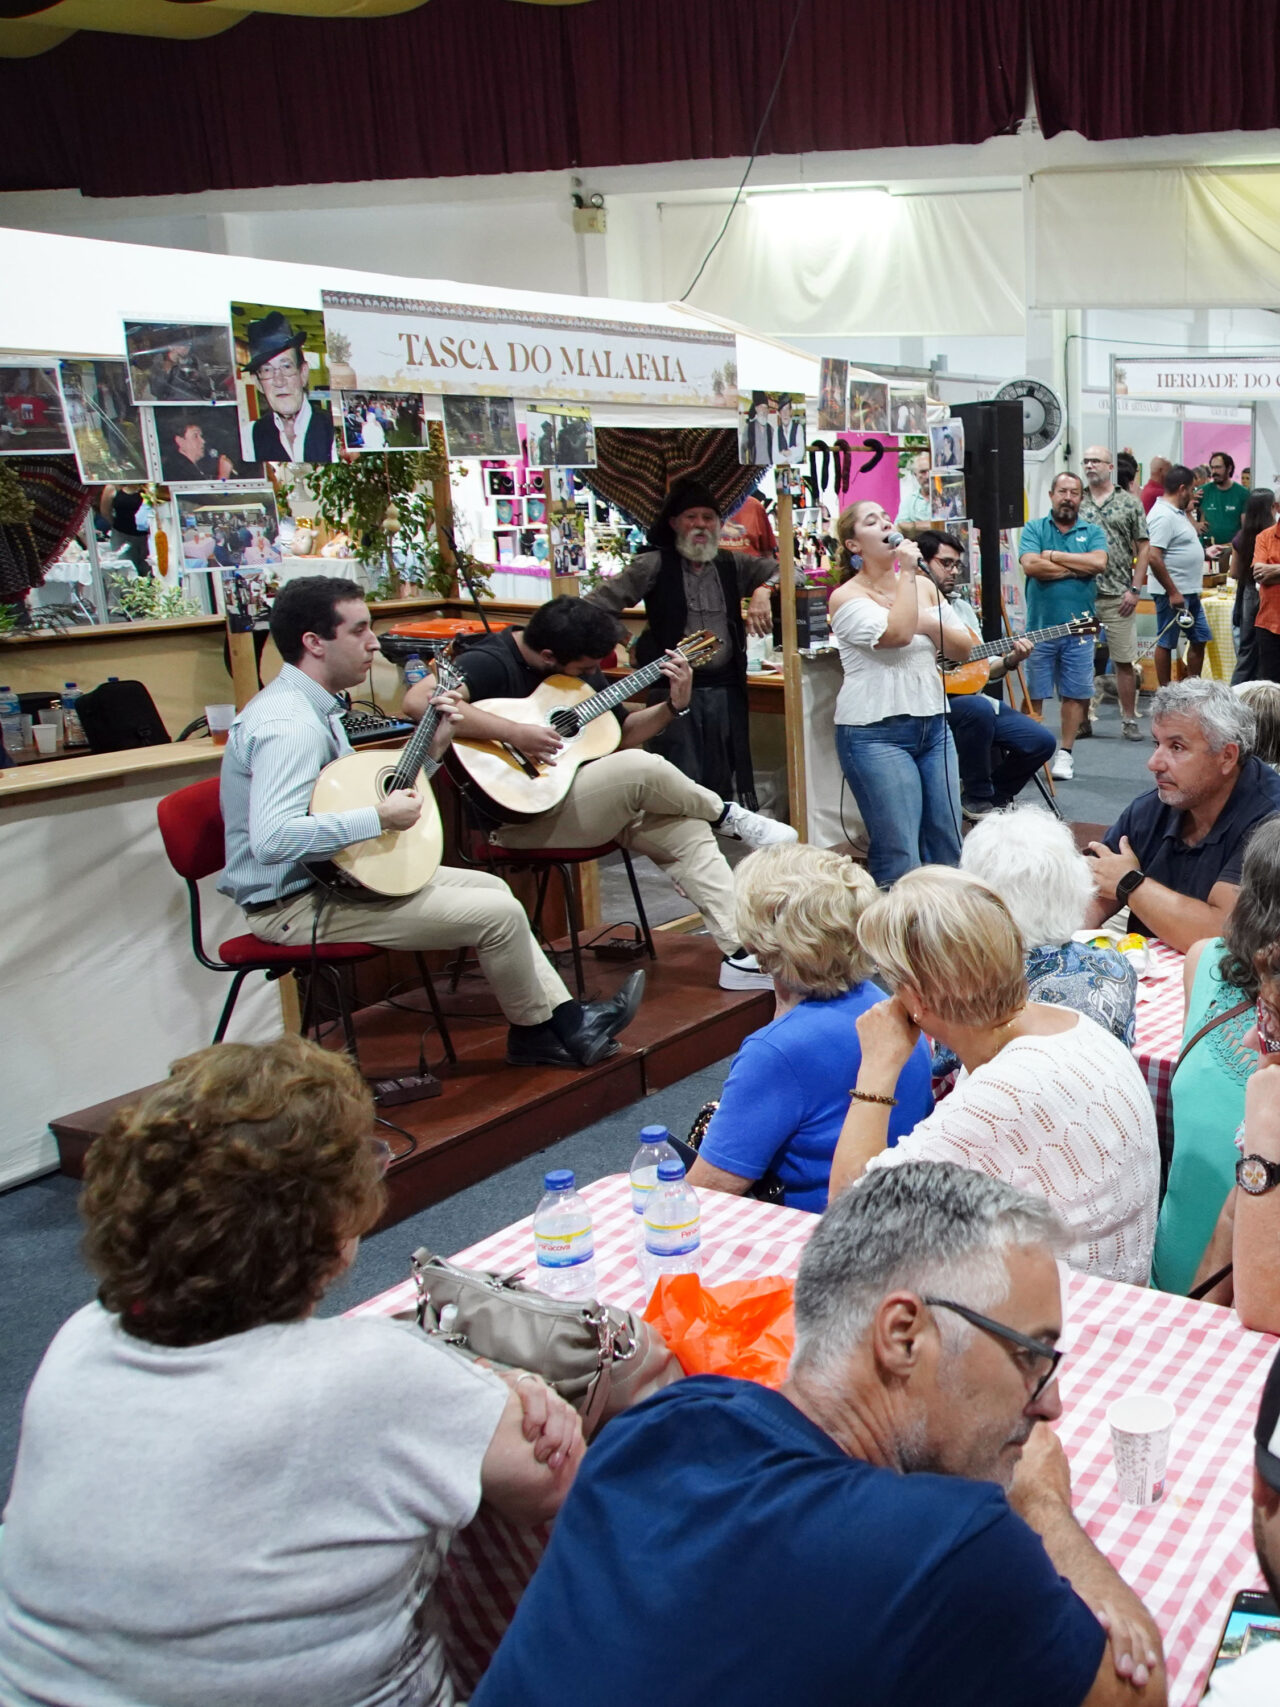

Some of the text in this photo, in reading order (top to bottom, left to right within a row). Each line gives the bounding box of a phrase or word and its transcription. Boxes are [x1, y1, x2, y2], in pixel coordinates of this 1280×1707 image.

[398, 332, 688, 383] TASCA DO MALAFAIA
[1157, 373, 1239, 389] HERDADE
[1243, 373, 1271, 389] DO
